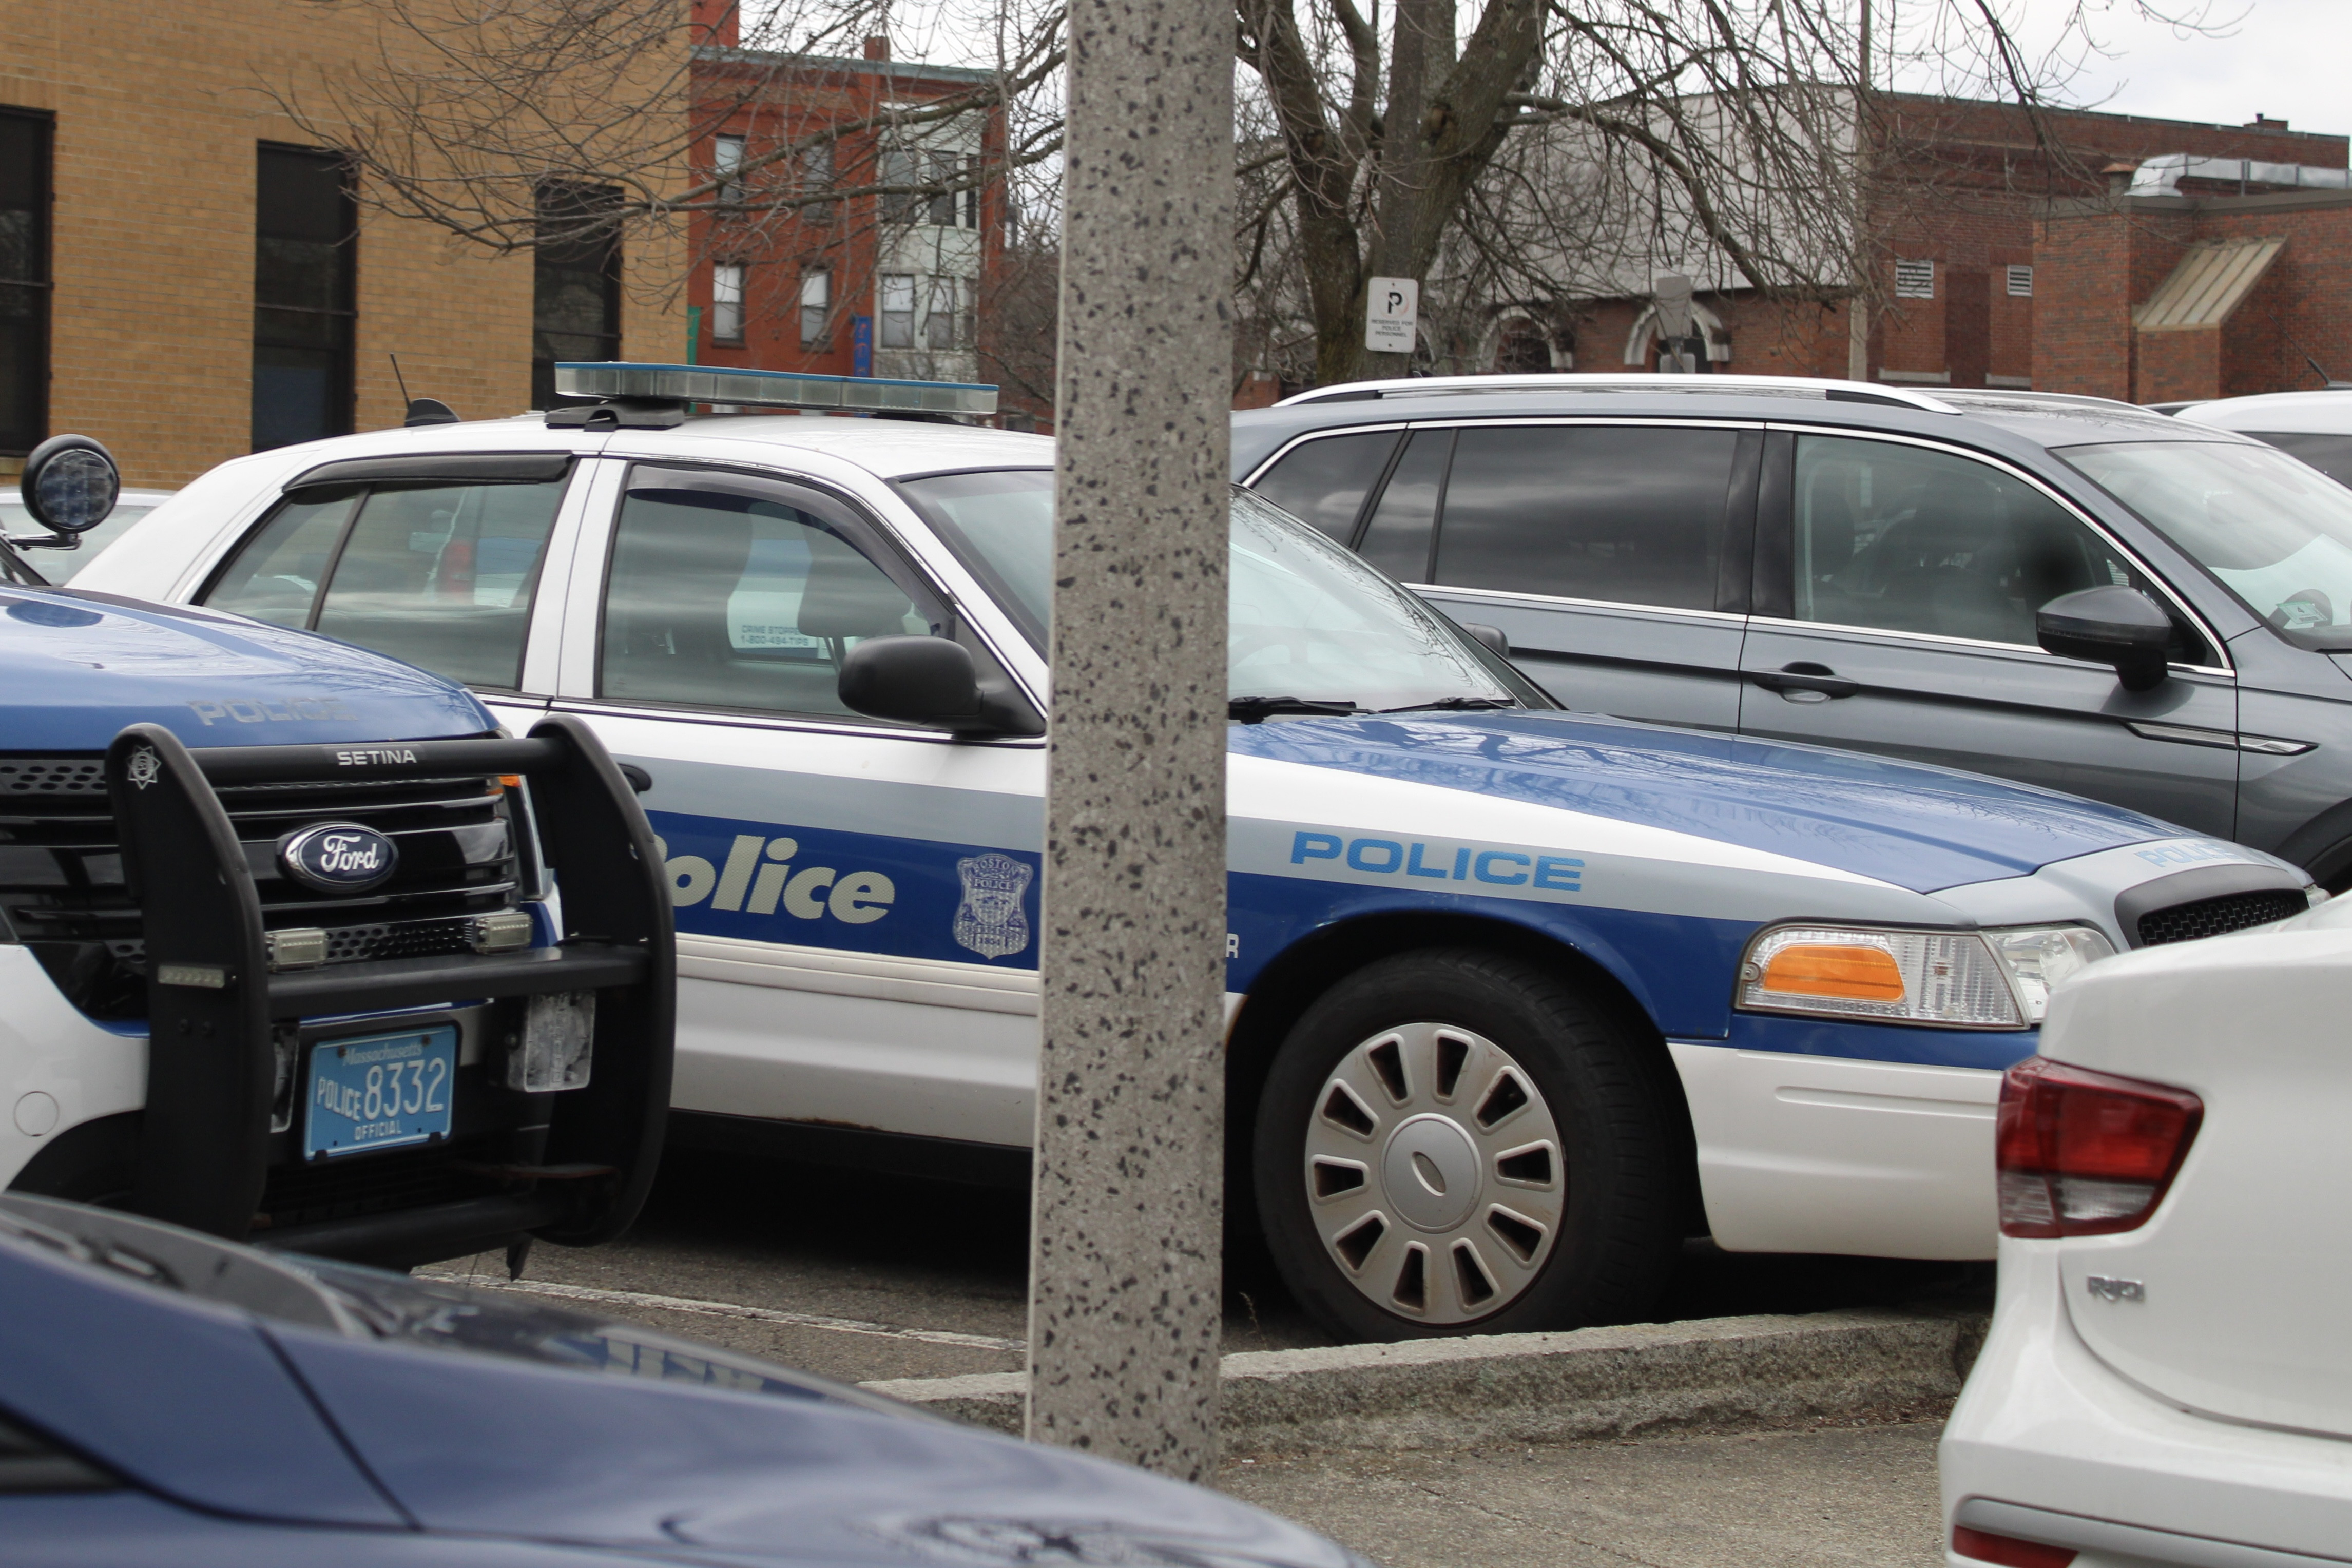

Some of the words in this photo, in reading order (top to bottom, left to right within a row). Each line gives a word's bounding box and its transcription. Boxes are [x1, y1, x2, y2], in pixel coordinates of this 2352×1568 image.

[742, 625, 766, 633] CRIME
[186, 697, 358, 726] POLICE
[336, 749, 417, 766] SETINA
[320, 834, 380, 873] Ford
[1290, 830, 1585, 892] POLICE
[2134, 842, 2241, 868] POLICE
[653, 834, 895, 924] olice
[973, 858, 1019, 877] BOSTON
[973, 878, 1013, 891] POLICE
[342, 1042, 423, 1066] Massachusetts
[316, 1076, 362, 1122] POLICE
[363, 1057, 447, 1121] 8332
[353, 1120, 402, 1141] OFFICIAL
